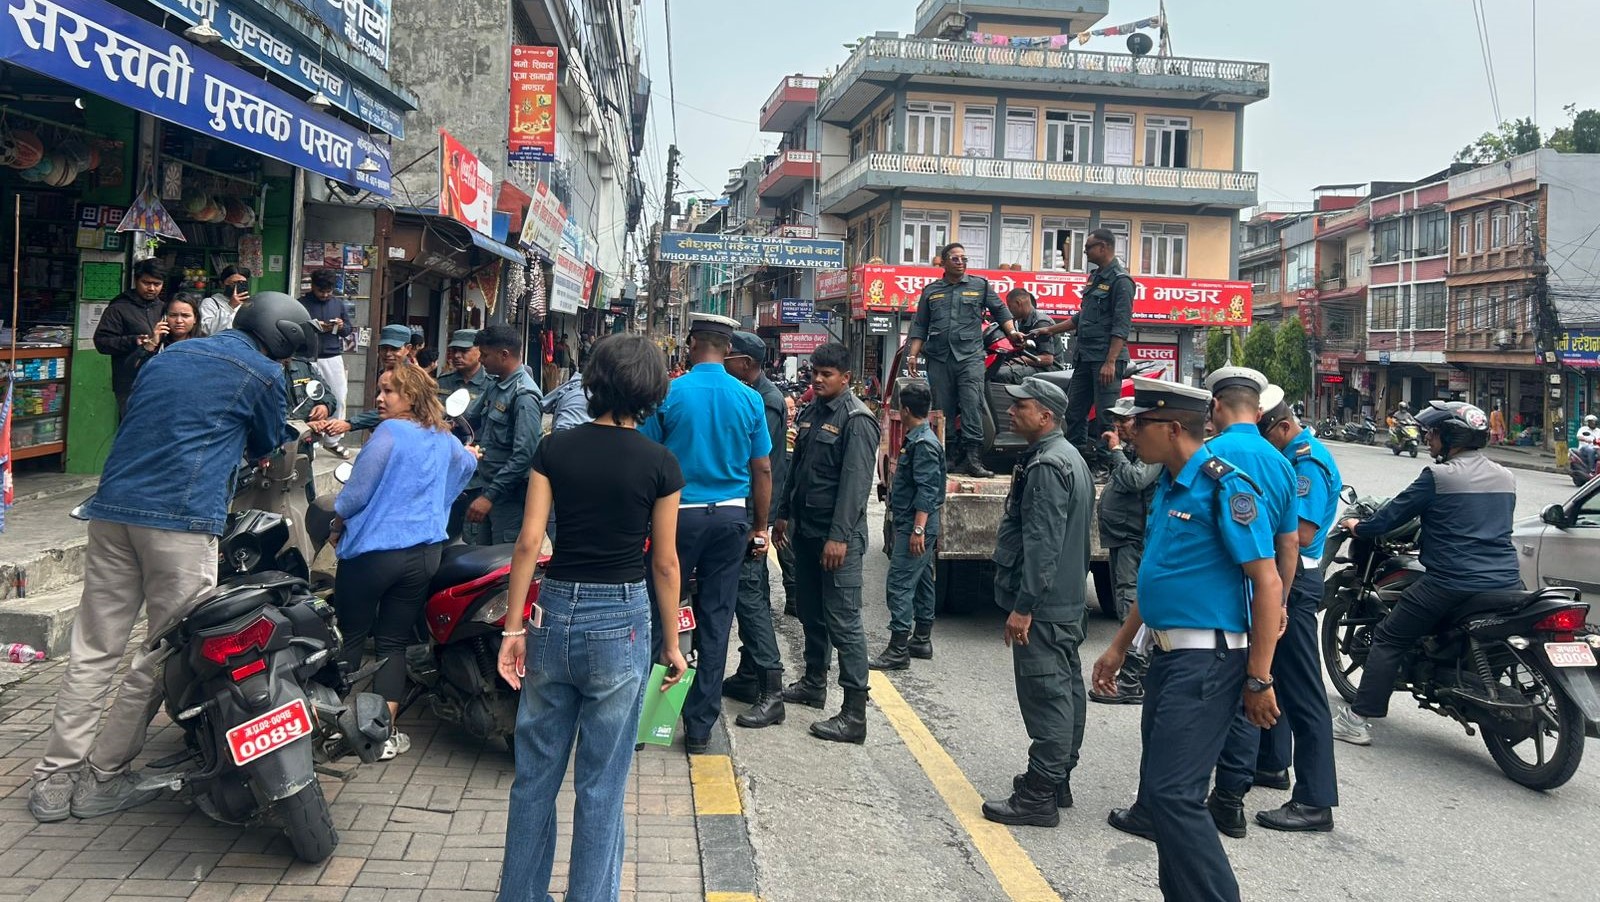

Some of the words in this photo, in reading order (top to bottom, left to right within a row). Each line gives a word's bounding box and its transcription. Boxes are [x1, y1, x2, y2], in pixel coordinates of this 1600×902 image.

[228, 10, 293, 66] पुस्तक
[299, 54, 344, 96] पसल
[8, 0, 194, 105] सरस्वती
[204, 74, 292, 143] पुस्तक
[300, 118, 353, 169] पसल
[785, 259, 840, 268] MARKET
[1153, 287, 1222, 304] भण्डार
[1137, 348, 1174, 359] पसल
